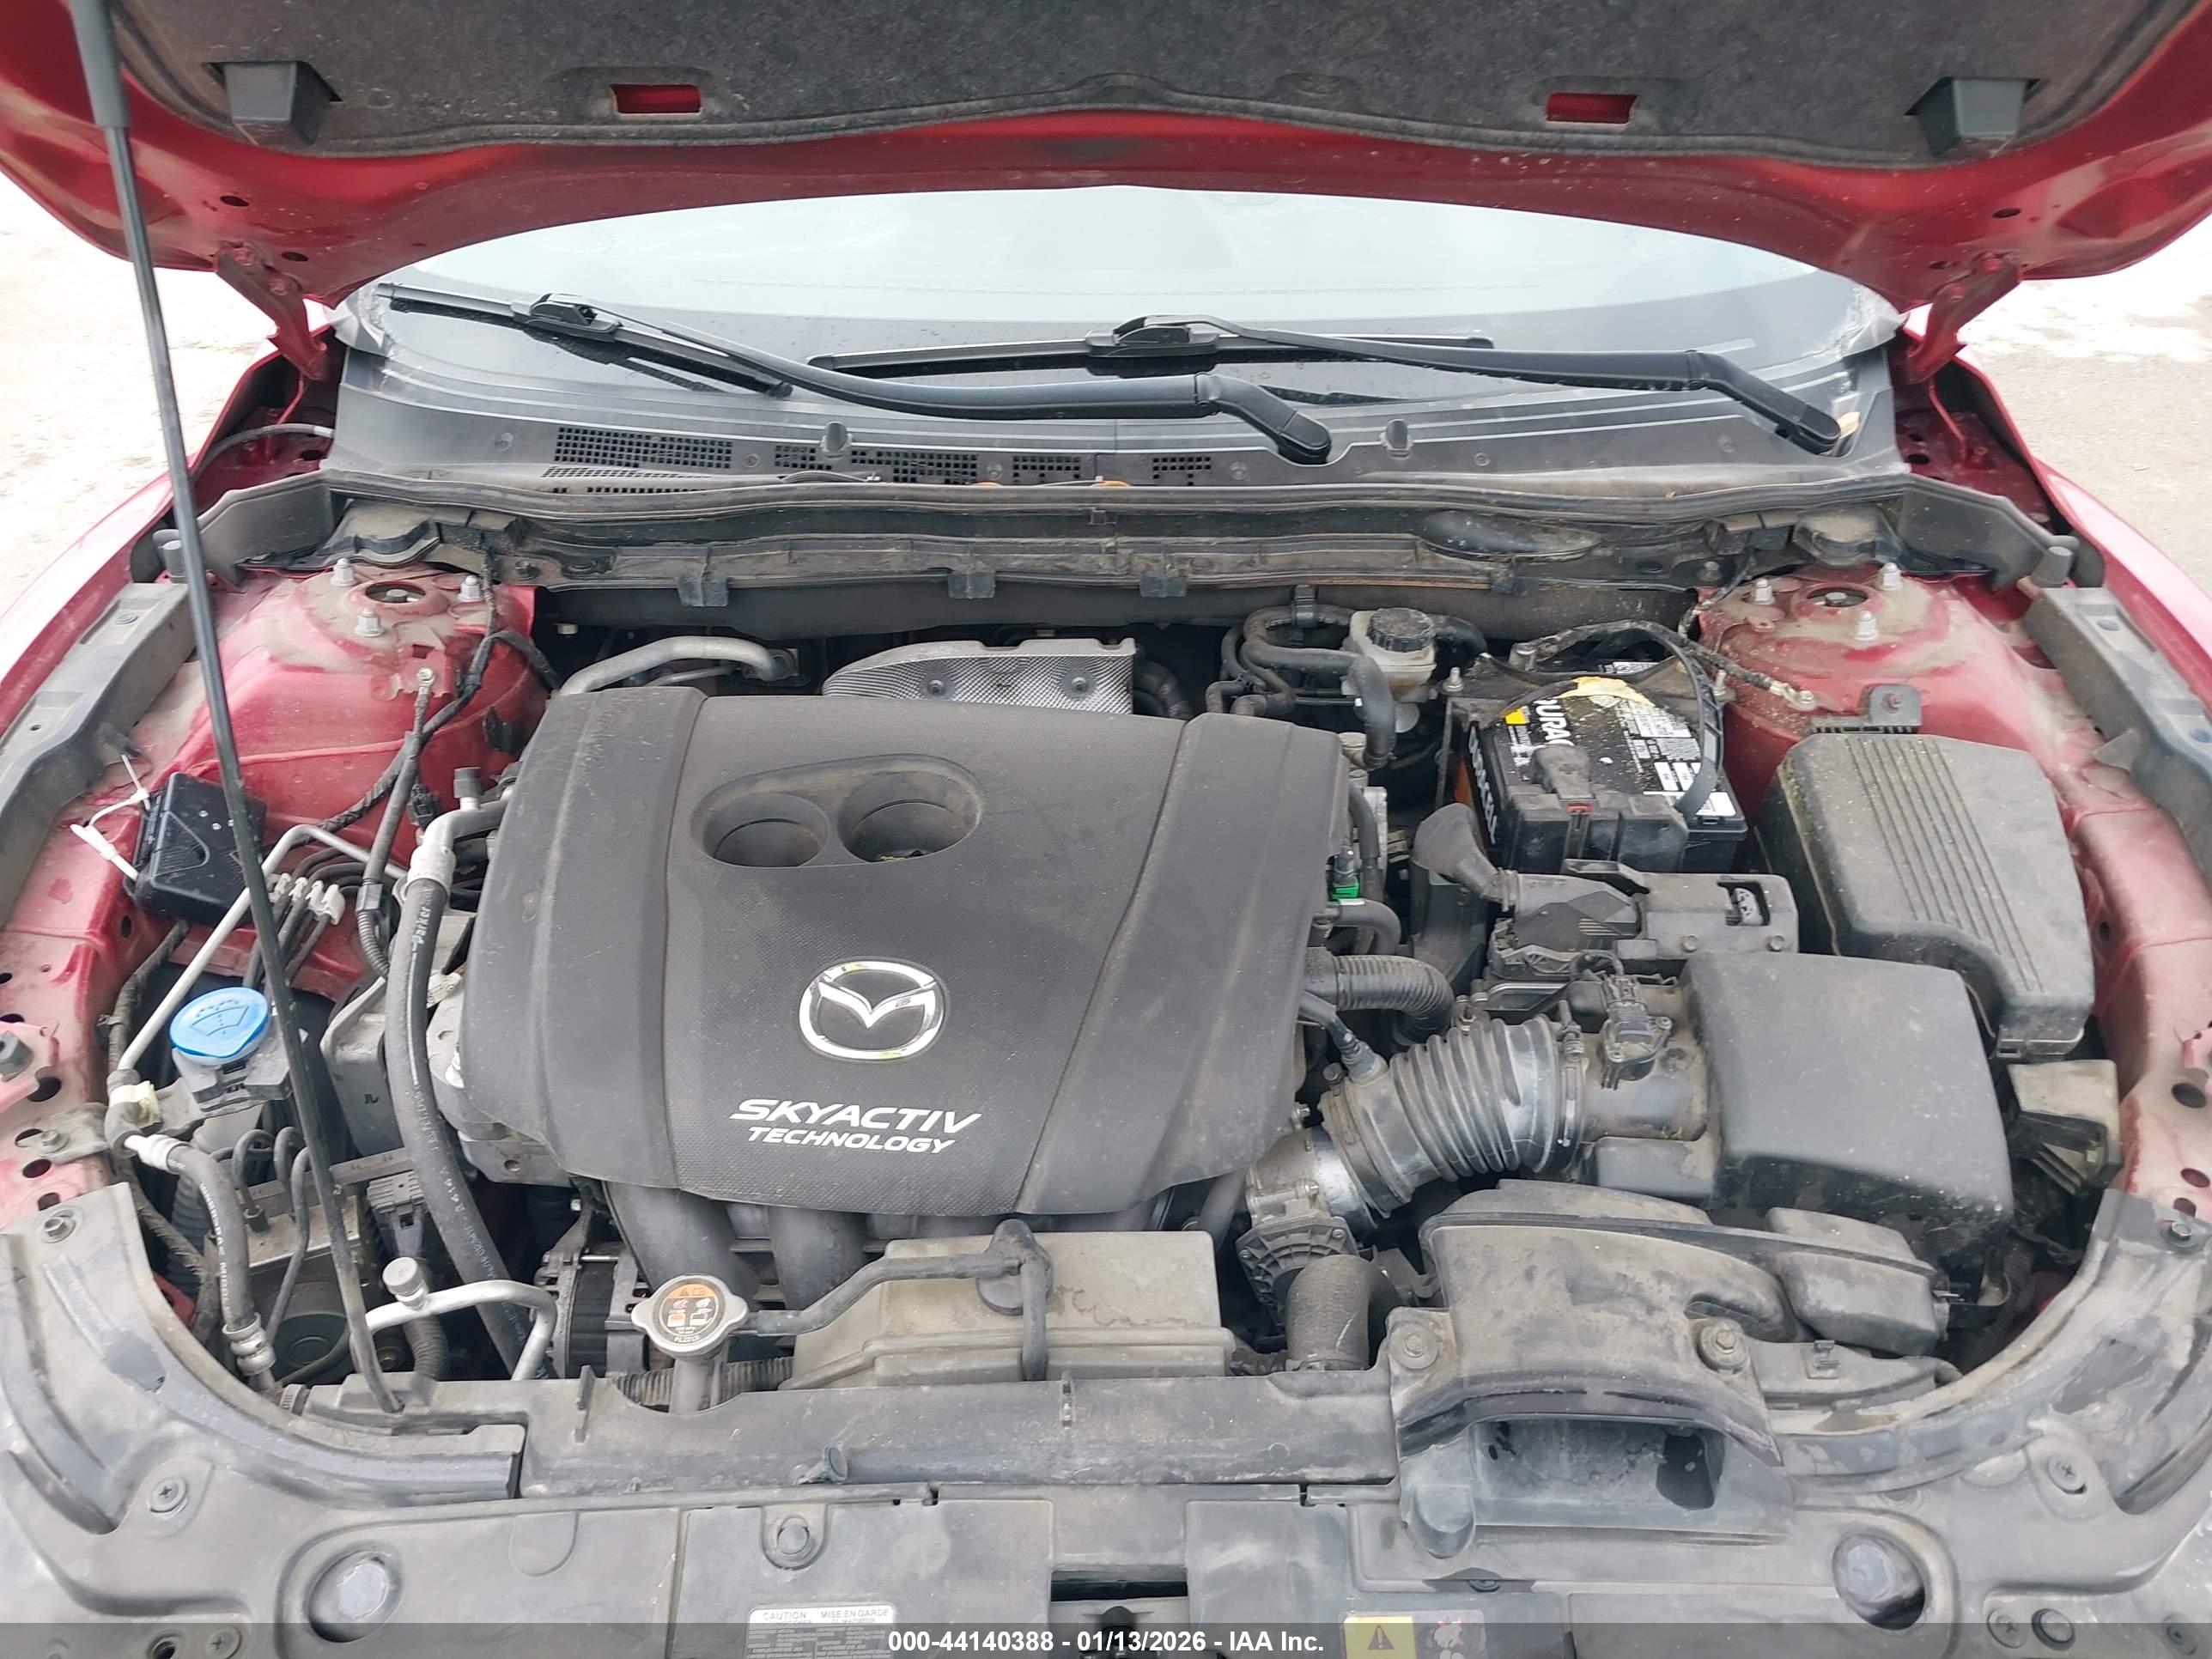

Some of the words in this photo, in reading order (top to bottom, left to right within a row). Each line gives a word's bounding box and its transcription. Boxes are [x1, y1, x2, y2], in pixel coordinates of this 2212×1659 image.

[729, 1099, 981, 1133] SKYACTIV
[748, 1127, 956, 1154] TECHNOLOGY
[763, 1611, 806, 1620] CAUTION
[820, 1610, 843, 1619] MISE
[845, 1609, 857, 1618] EN
[857, 1608, 889, 1617] GARDE
